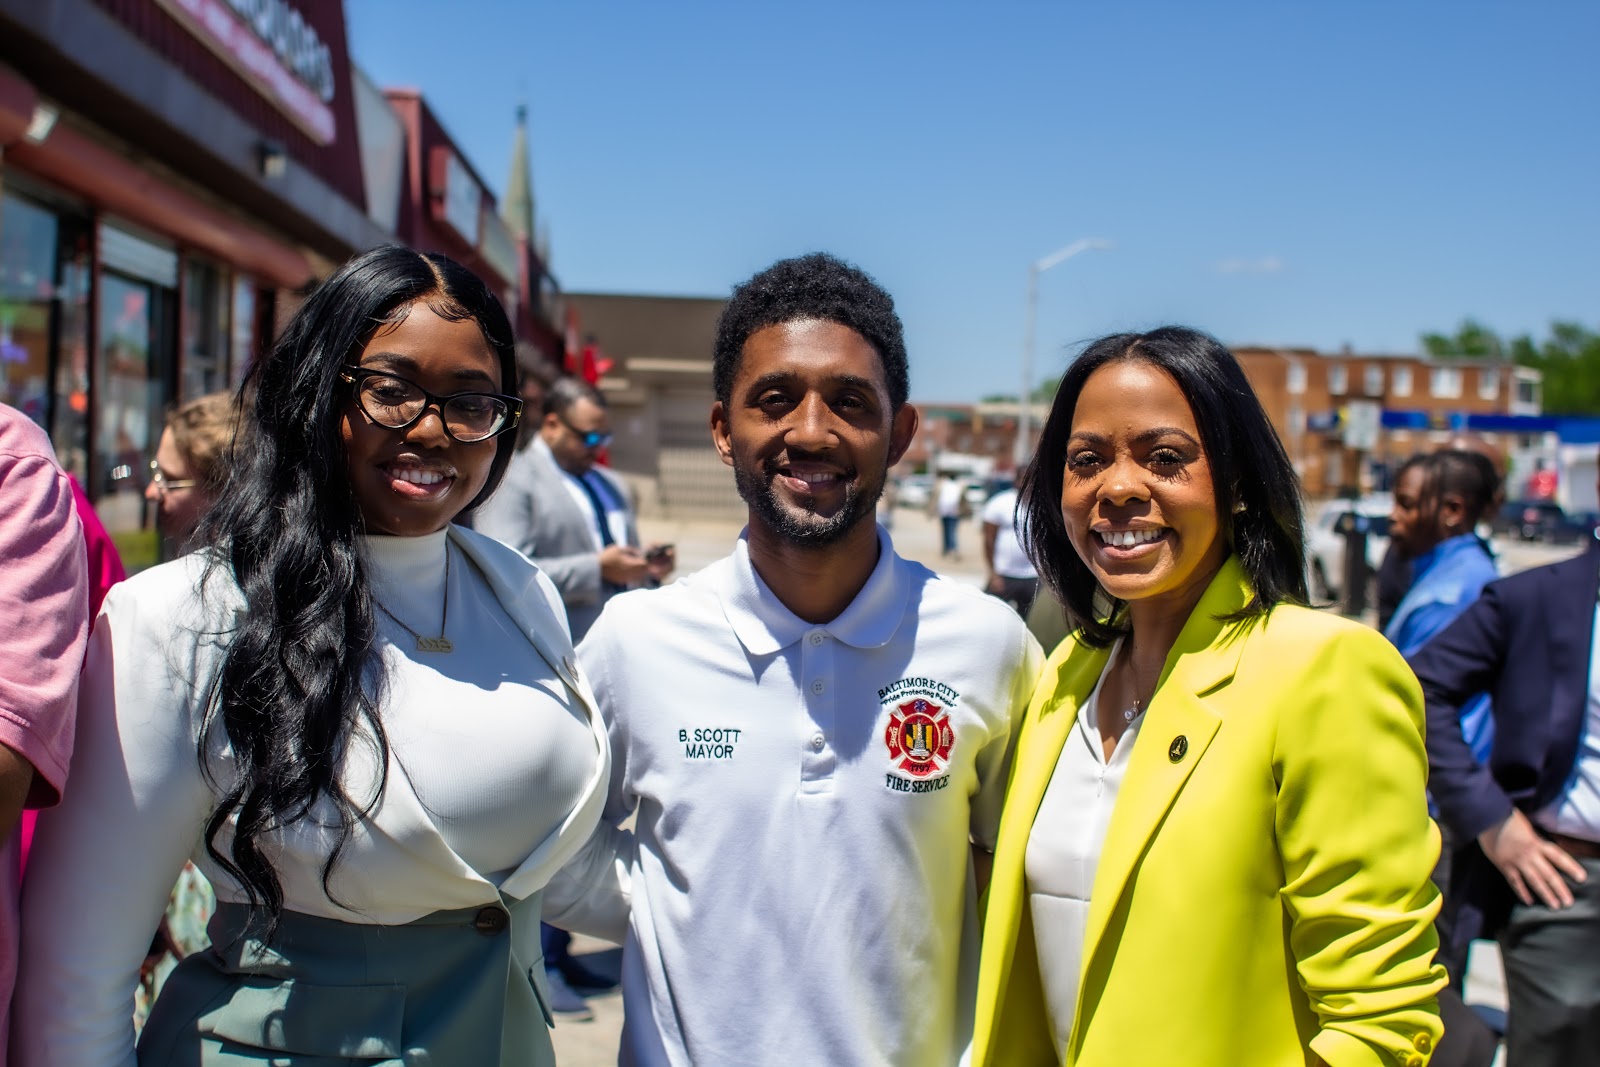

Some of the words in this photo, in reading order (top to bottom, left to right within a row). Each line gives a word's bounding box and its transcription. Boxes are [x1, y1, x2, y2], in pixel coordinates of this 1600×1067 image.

[878, 678, 936, 699] BALTIMORE
[937, 682, 960, 700] CITY
[901, 688, 935, 698] Protecting
[679, 729, 691, 742] B.
[694, 728, 742, 743] SCOTT
[686, 743, 734, 759] MAYOR
[910, 763, 931, 773] 1797
[886, 773, 911, 792] FIRE
[912, 774, 950, 793] SERVICE
